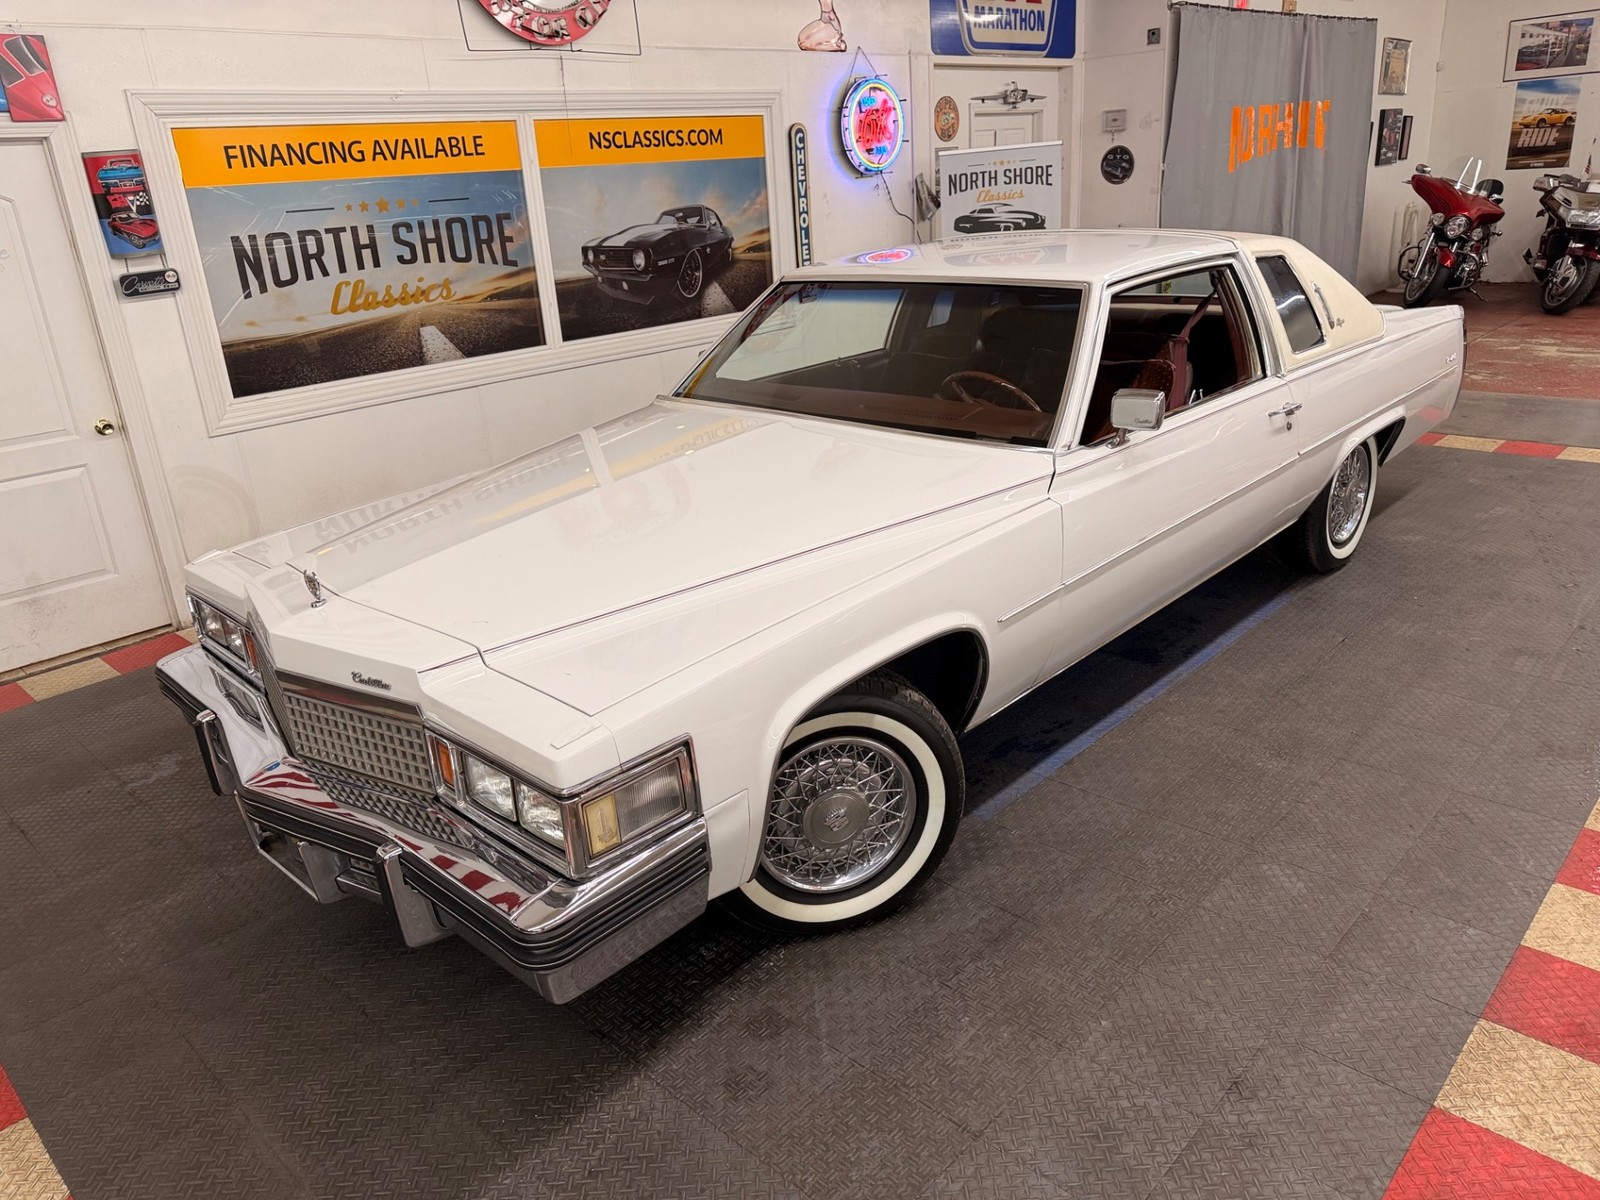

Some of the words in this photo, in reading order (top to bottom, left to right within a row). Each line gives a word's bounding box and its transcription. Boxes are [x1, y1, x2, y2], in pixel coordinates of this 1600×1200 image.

[973, 5, 1046, 32] MARATHON
[588, 128, 724, 150] NSCLASSICS.COM
[1516, 127, 1560, 148] RIDE
[223, 140, 367, 170] FINANCING
[371, 135, 486, 162] AVAILABLE
[948, 169, 998, 196] NORTH
[1003, 164, 1053, 187] SHORE
[975, 187, 1025, 203] Classics
[230, 223, 382, 300] NORTH
[392, 212, 519, 268] SHORE
[330, 275, 457, 316] Classics
